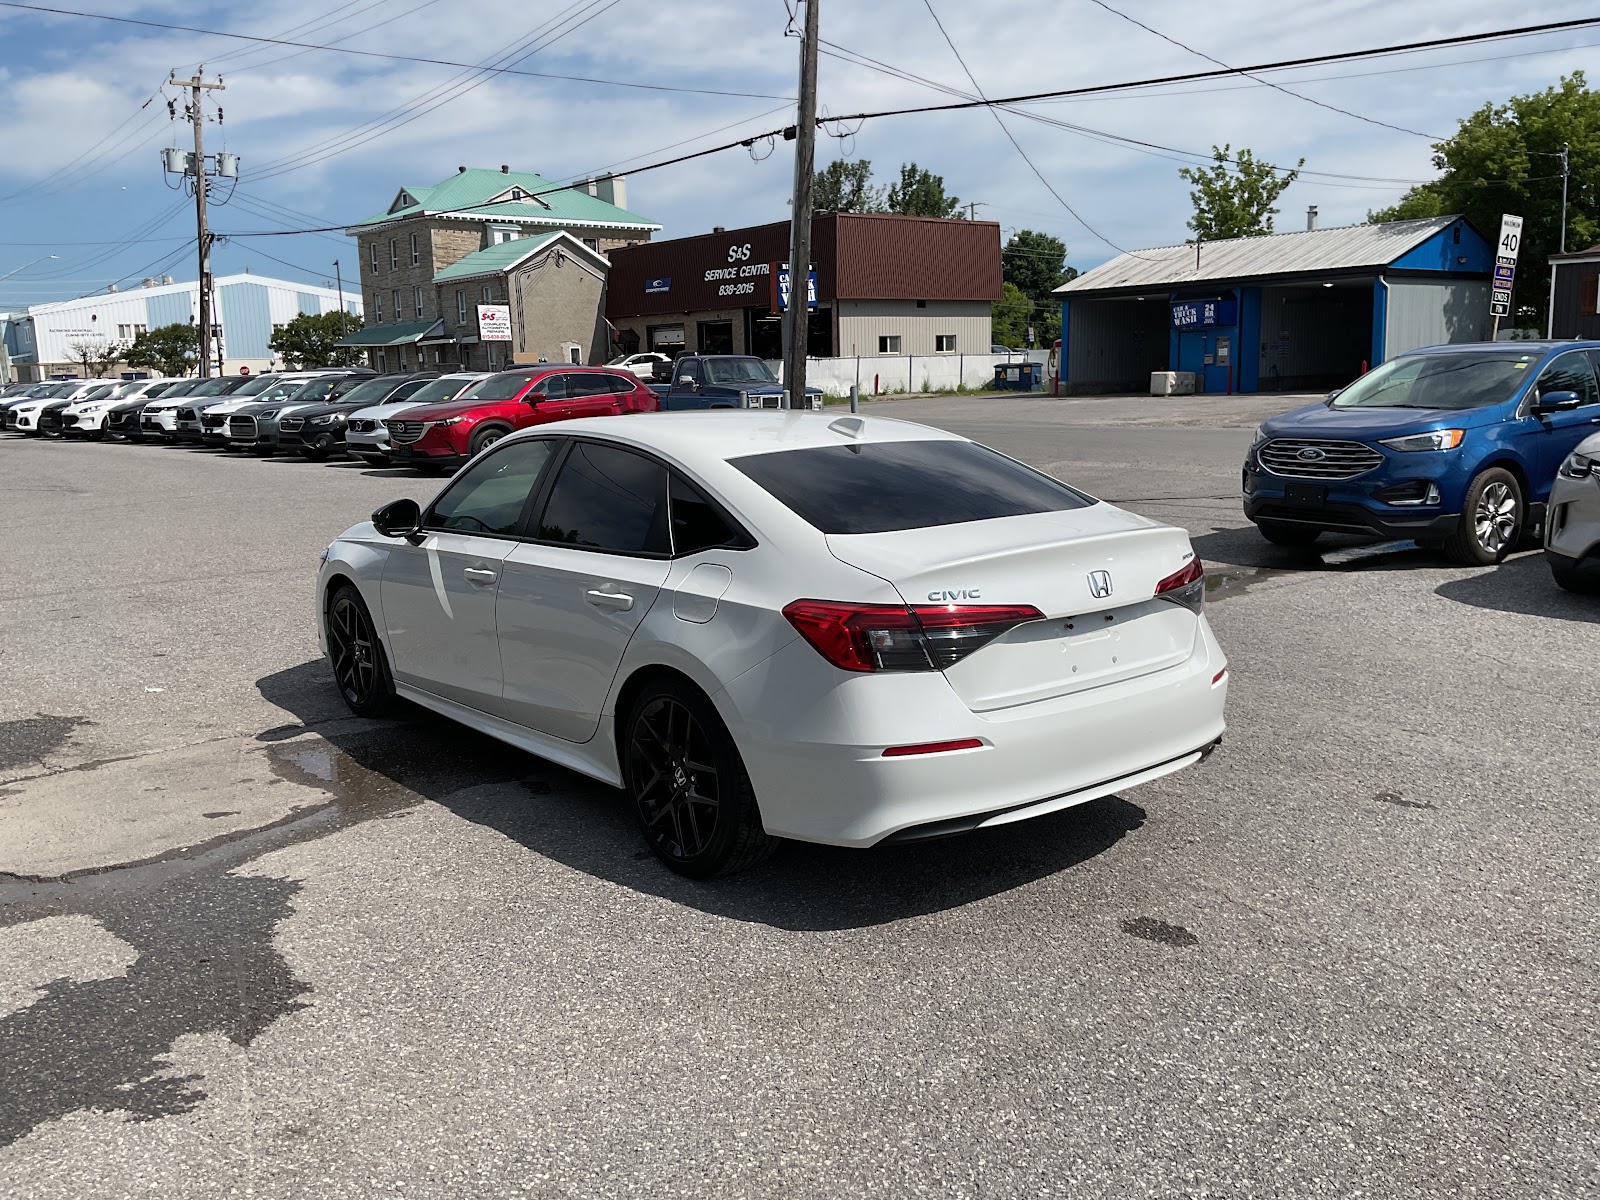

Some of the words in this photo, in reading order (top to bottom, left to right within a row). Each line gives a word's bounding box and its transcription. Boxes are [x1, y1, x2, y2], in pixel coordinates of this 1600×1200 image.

[1502, 234, 1518, 252] 40
[727, 243, 752, 262] S&S
[704, 267, 738, 281] SERVICE
[718, 282, 754, 296] 838-2015
[1204, 303, 1214, 311] 24
[1174, 314, 1197, 326] WASH
[927, 588, 982, 601] CIVIC
